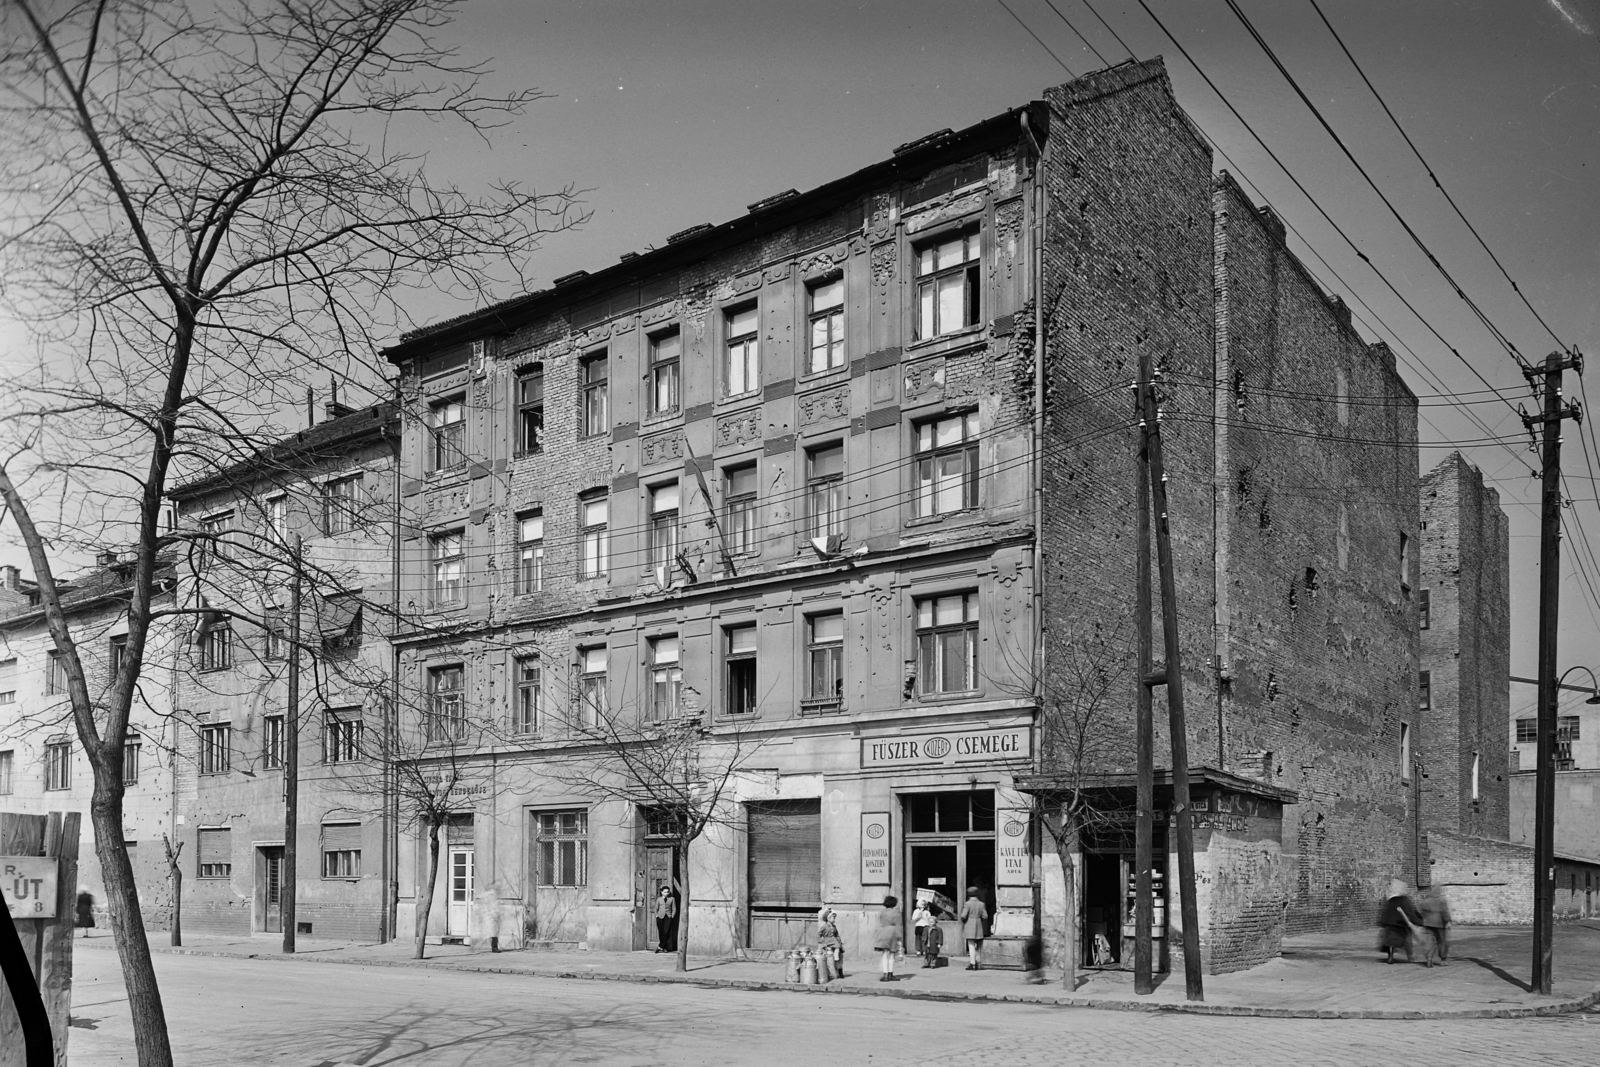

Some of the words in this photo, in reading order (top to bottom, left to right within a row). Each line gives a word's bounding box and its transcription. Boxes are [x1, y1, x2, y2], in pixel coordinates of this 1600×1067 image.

[956, 734, 1019, 755] CSEMEGE
[1005, 859, 1024, 868] ITAL
[34, 901, 43, 913] 8
